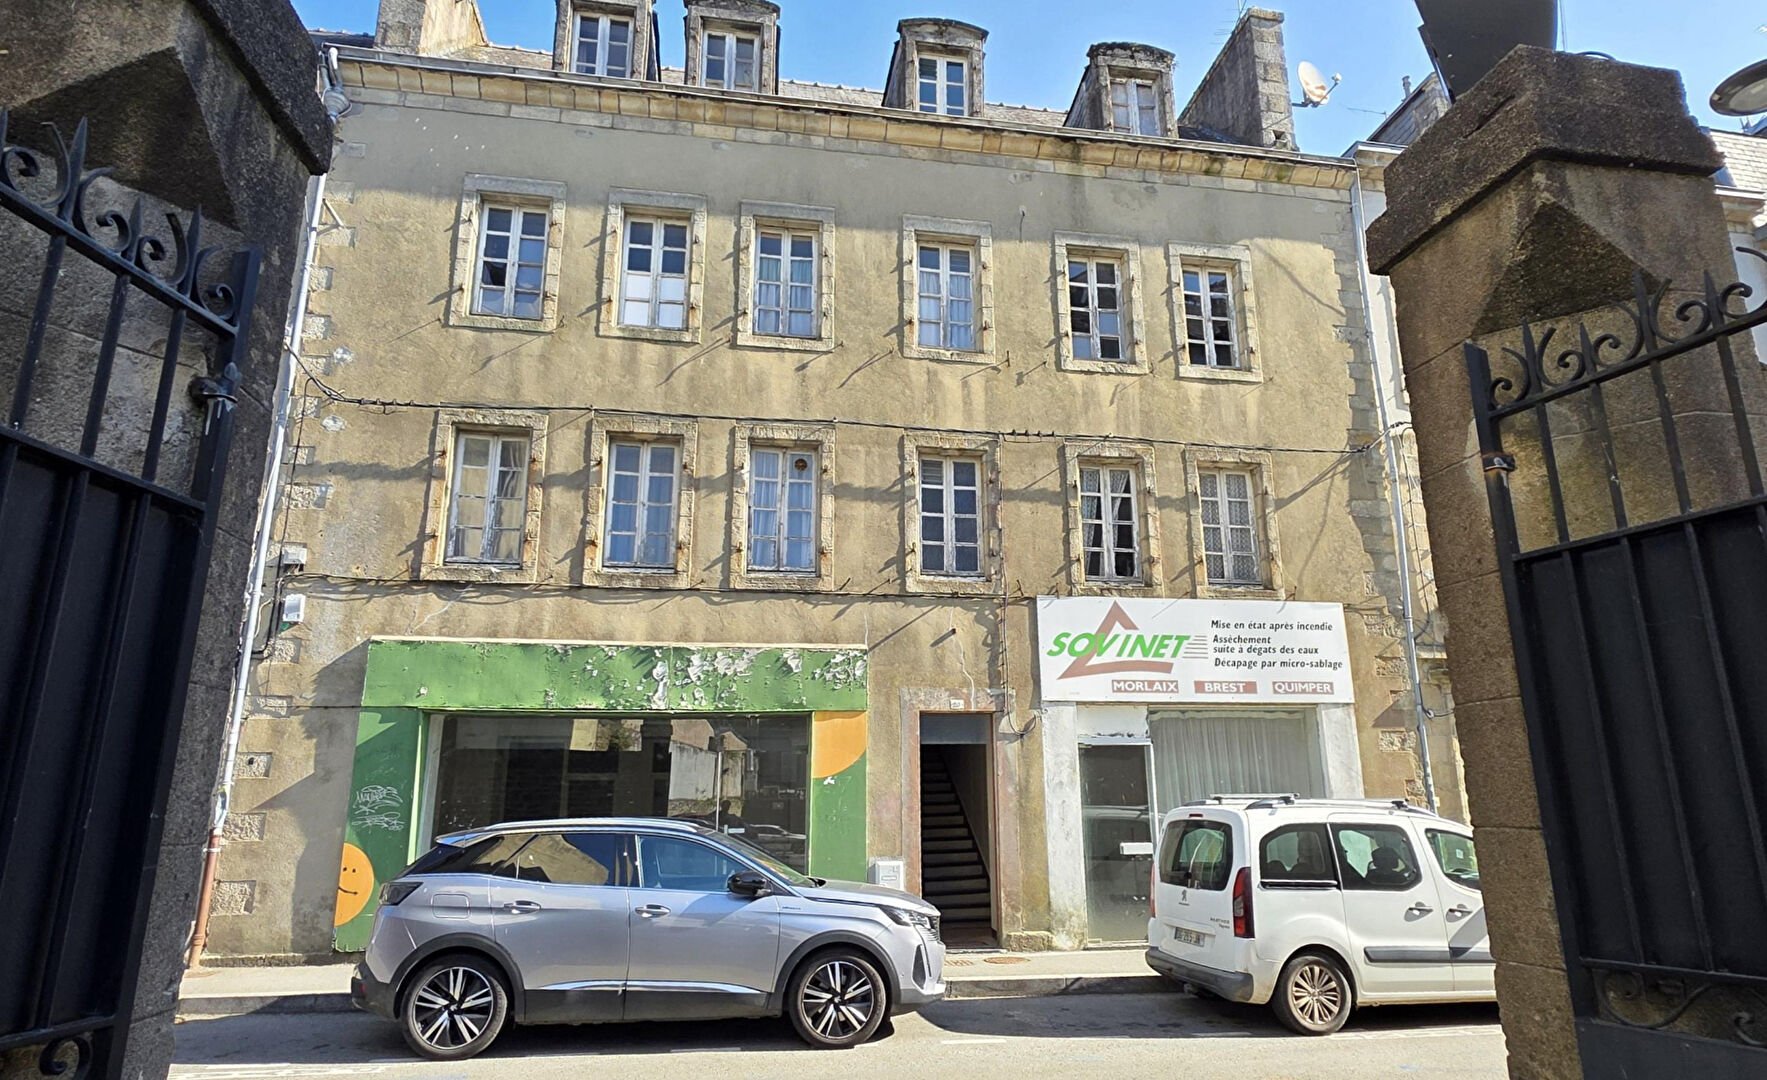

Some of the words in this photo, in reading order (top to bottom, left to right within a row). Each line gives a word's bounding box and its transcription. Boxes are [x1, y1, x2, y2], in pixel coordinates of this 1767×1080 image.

[1211, 620, 1231, 629] Mise
[1248, 620, 1266, 630] état
[1269, 621, 1294, 632] après
[1297, 621, 1333, 631] incendie
[1046, 632, 1190, 658] SOVINET
[1213, 644, 1235, 653] suite
[1238, 644, 1244, 653] à
[1279, 645, 1295, 654] des
[1298, 646, 1319, 654] eaux
[1214, 657, 1258, 670] Décapage
[1261, 660, 1277, 670] par
[1280, 658, 1343, 670] micro-sablage
[1113, 680, 1178, 692] MORLAIX
[1204, 682, 1246, 693] BREST
[1274, 682, 1332, 695] QUIMPER
